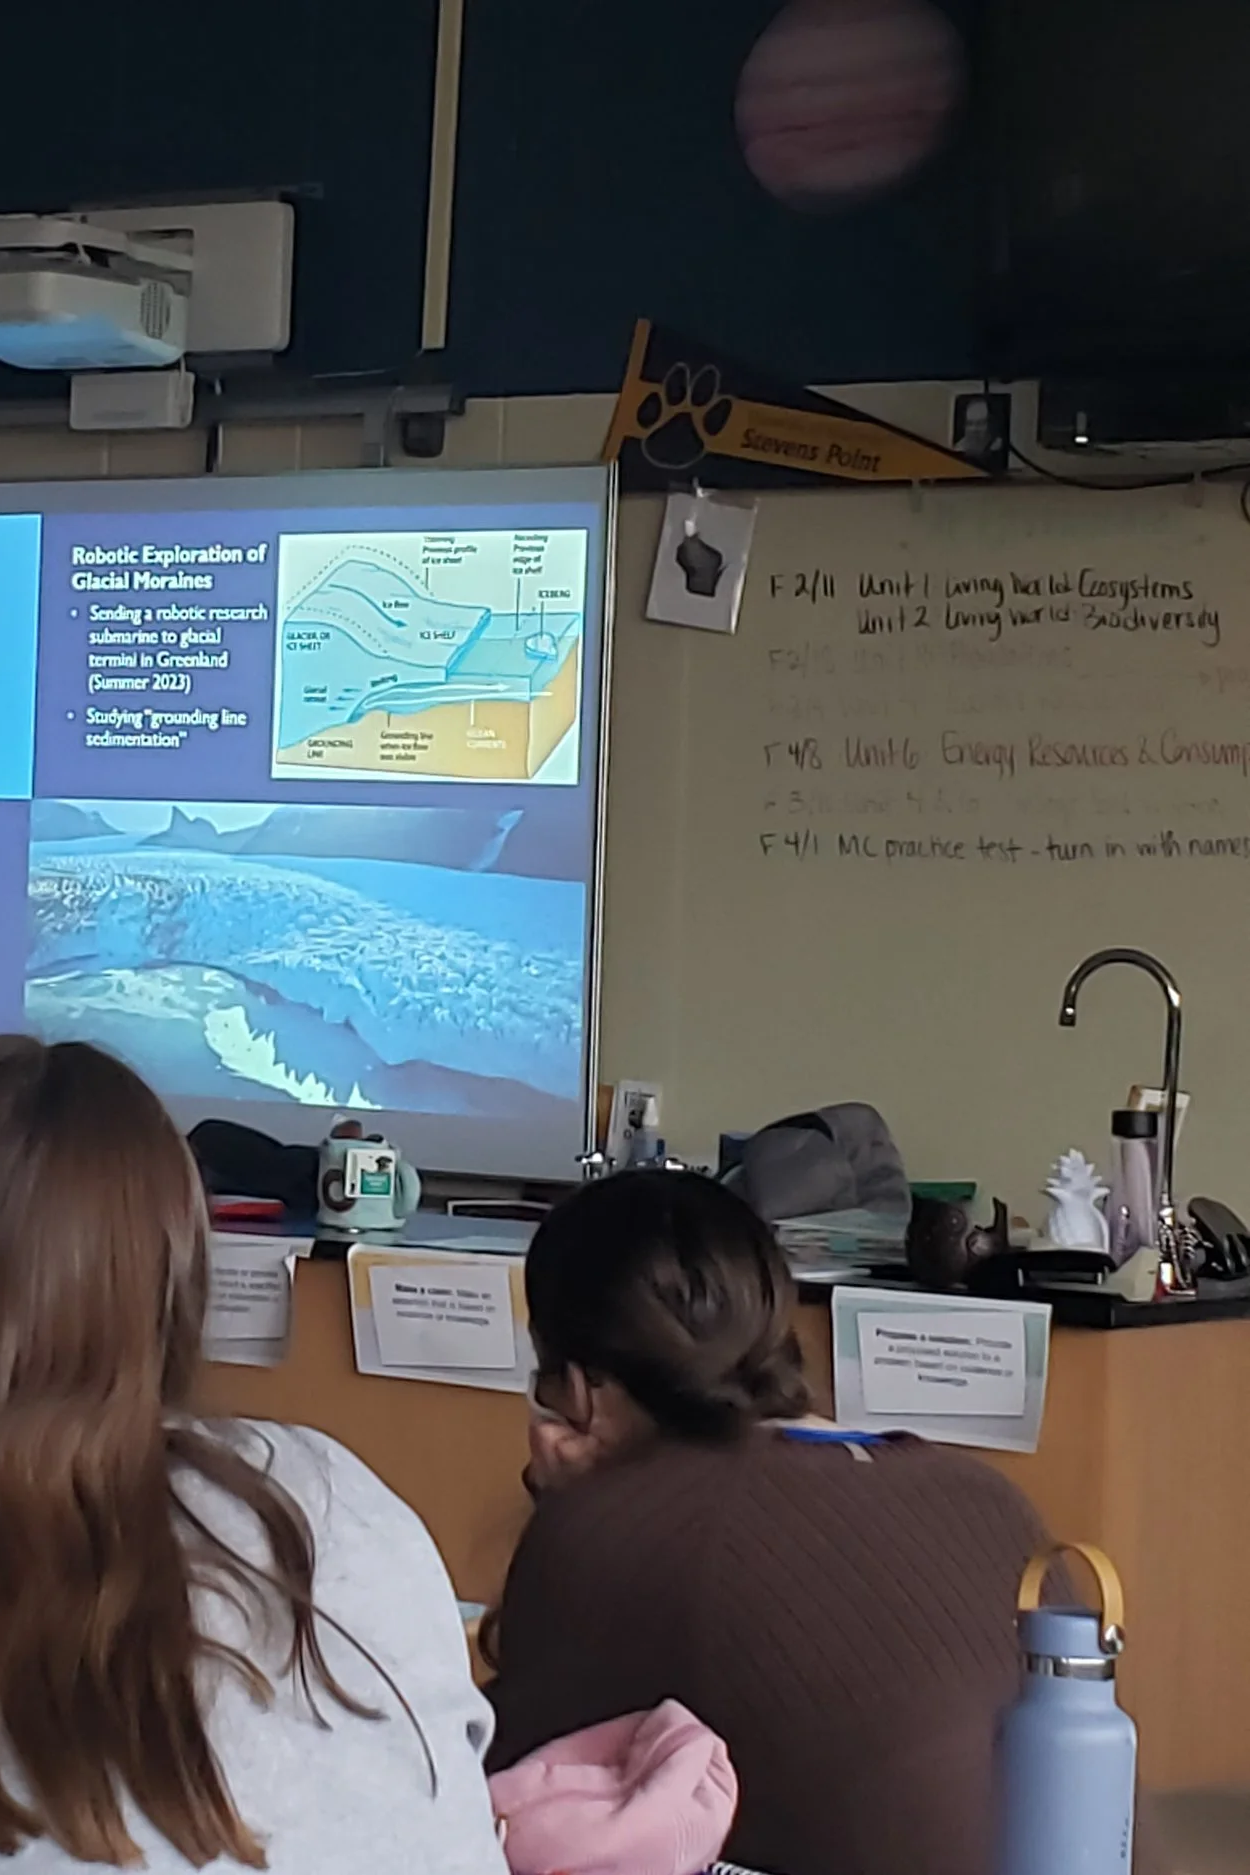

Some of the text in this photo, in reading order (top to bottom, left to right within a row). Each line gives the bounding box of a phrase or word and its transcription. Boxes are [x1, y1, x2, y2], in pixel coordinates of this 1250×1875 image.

[740, 427, 882, 473] Stevens Point
[72, 543, 268, 569] Robotic Exploration of
[71, 570, 213, 591] Glacial Moraines
[770, 569, 835, 605] F 2/11
[859, 570, 914, 598] Unit
[1078, 568, 1194, 610] Ecosystems
[89, 603, 268, 625] Sending a robotic research
[858, 604, 905, 635] Unit
[914, 605, 931, 628] 2
[1082, 603, 1221, 648] Biodiversity
[88, 627, 221, 648] submarine to glacial
[88, 651, 228, 668] termini in Greenland
[88, 674, 191, 694] (Summer 2023)
[86, 707, 143, 729] Studying
[221, 709, 247, 726] line
[85, 731, 188, 748] sedimentation"
[845, 736, 898, 768] Unit
[903, 737, 920, 769] 6
[942, 730, 1015, 781] Energy
[1028, 731, 1130, 767] Resources
[759, 832, 777, 856] F
[784, 828, 818, 861] 4/1
[838, 833, 878, 857] MC
[885, 834, 966, 866] practice
[976, 835, 1023, 863] test
[1046, 833, 1095, 860] turn
[1105, 835, 1126, 858] in
[1137, 829, 1180, 857] with
